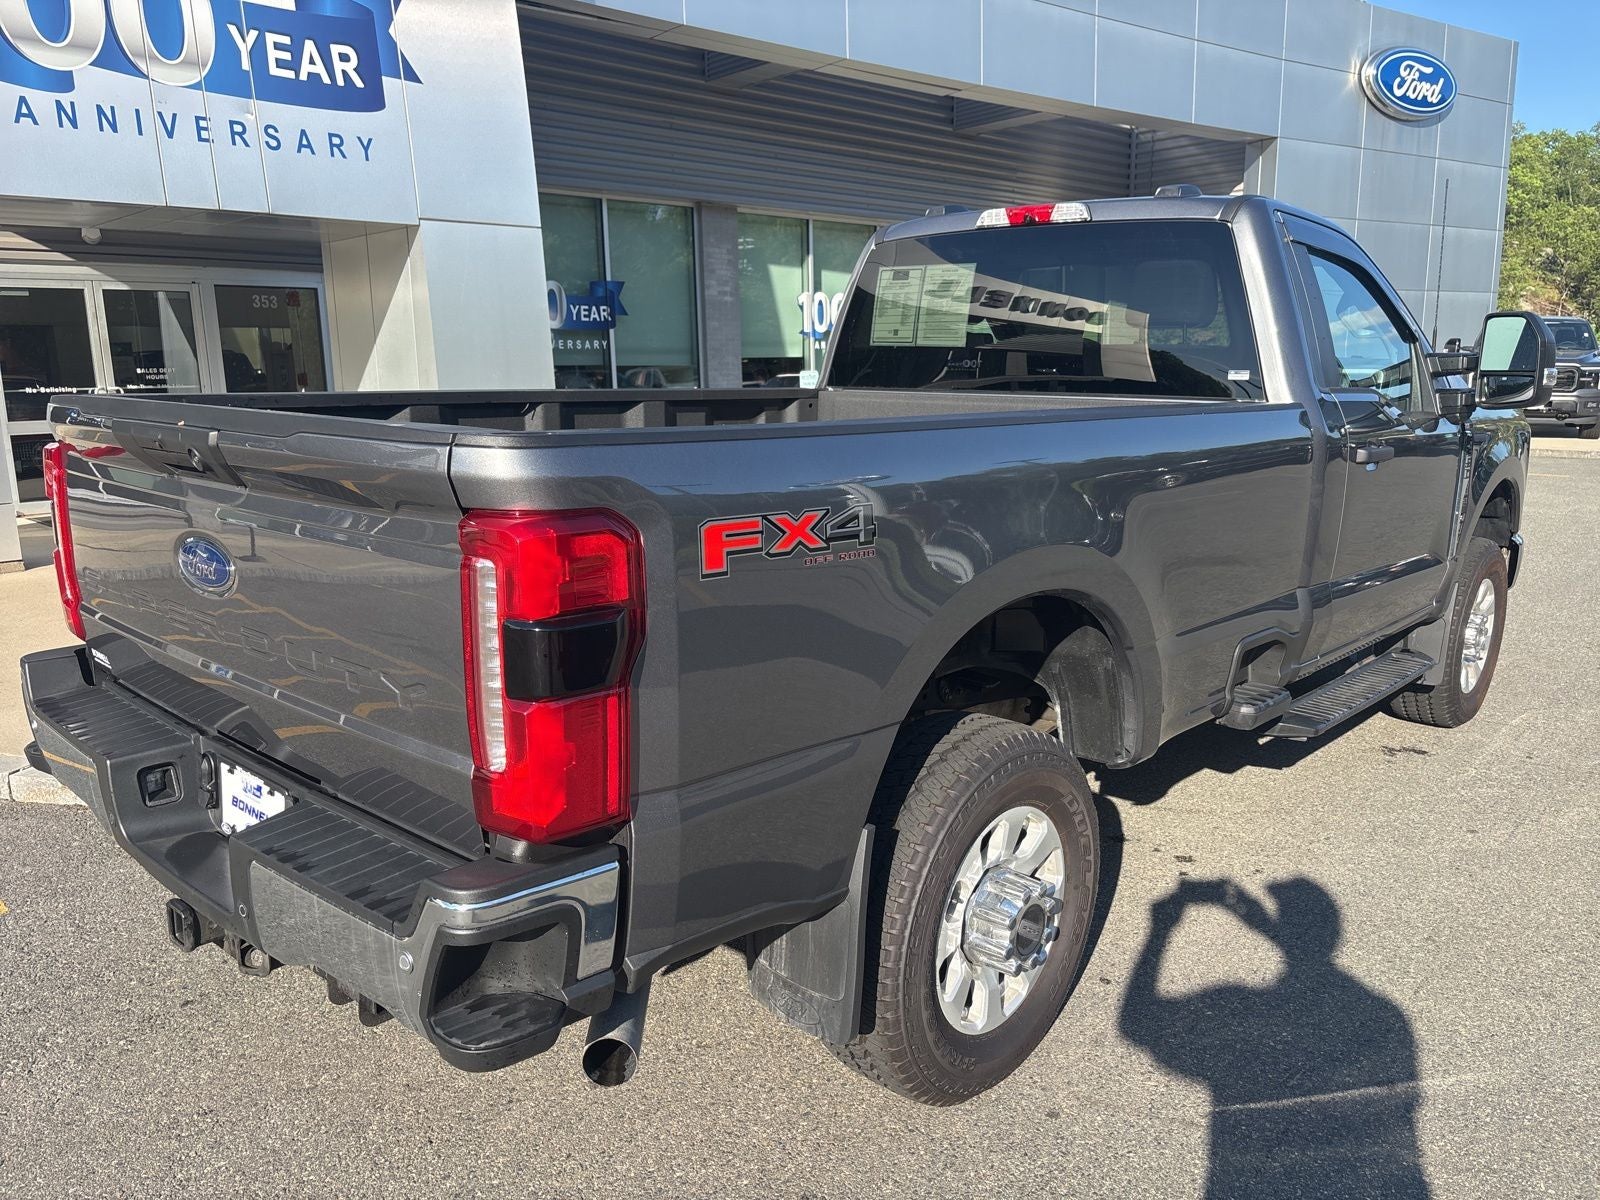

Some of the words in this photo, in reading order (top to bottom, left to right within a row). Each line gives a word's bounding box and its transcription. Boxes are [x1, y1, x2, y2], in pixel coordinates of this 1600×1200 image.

[226, 23, 366, 89] YEAR
[1393, 60, 1444, 103] Ford
[13, 94, 374, 162] ANNIVERSARY
[252, 294, 278, 309] 353
[570, 304, 612, 321] YEAR
[551, 339, 608, 350] ERSARY
[698, 503, 877, 581] FX4
[187, 547, 218, 580] Ford
[804, 553, 833, 566] OFF
[839, 549, 876, 561] ROAD
[231, 795, 269, 821] BONNE
